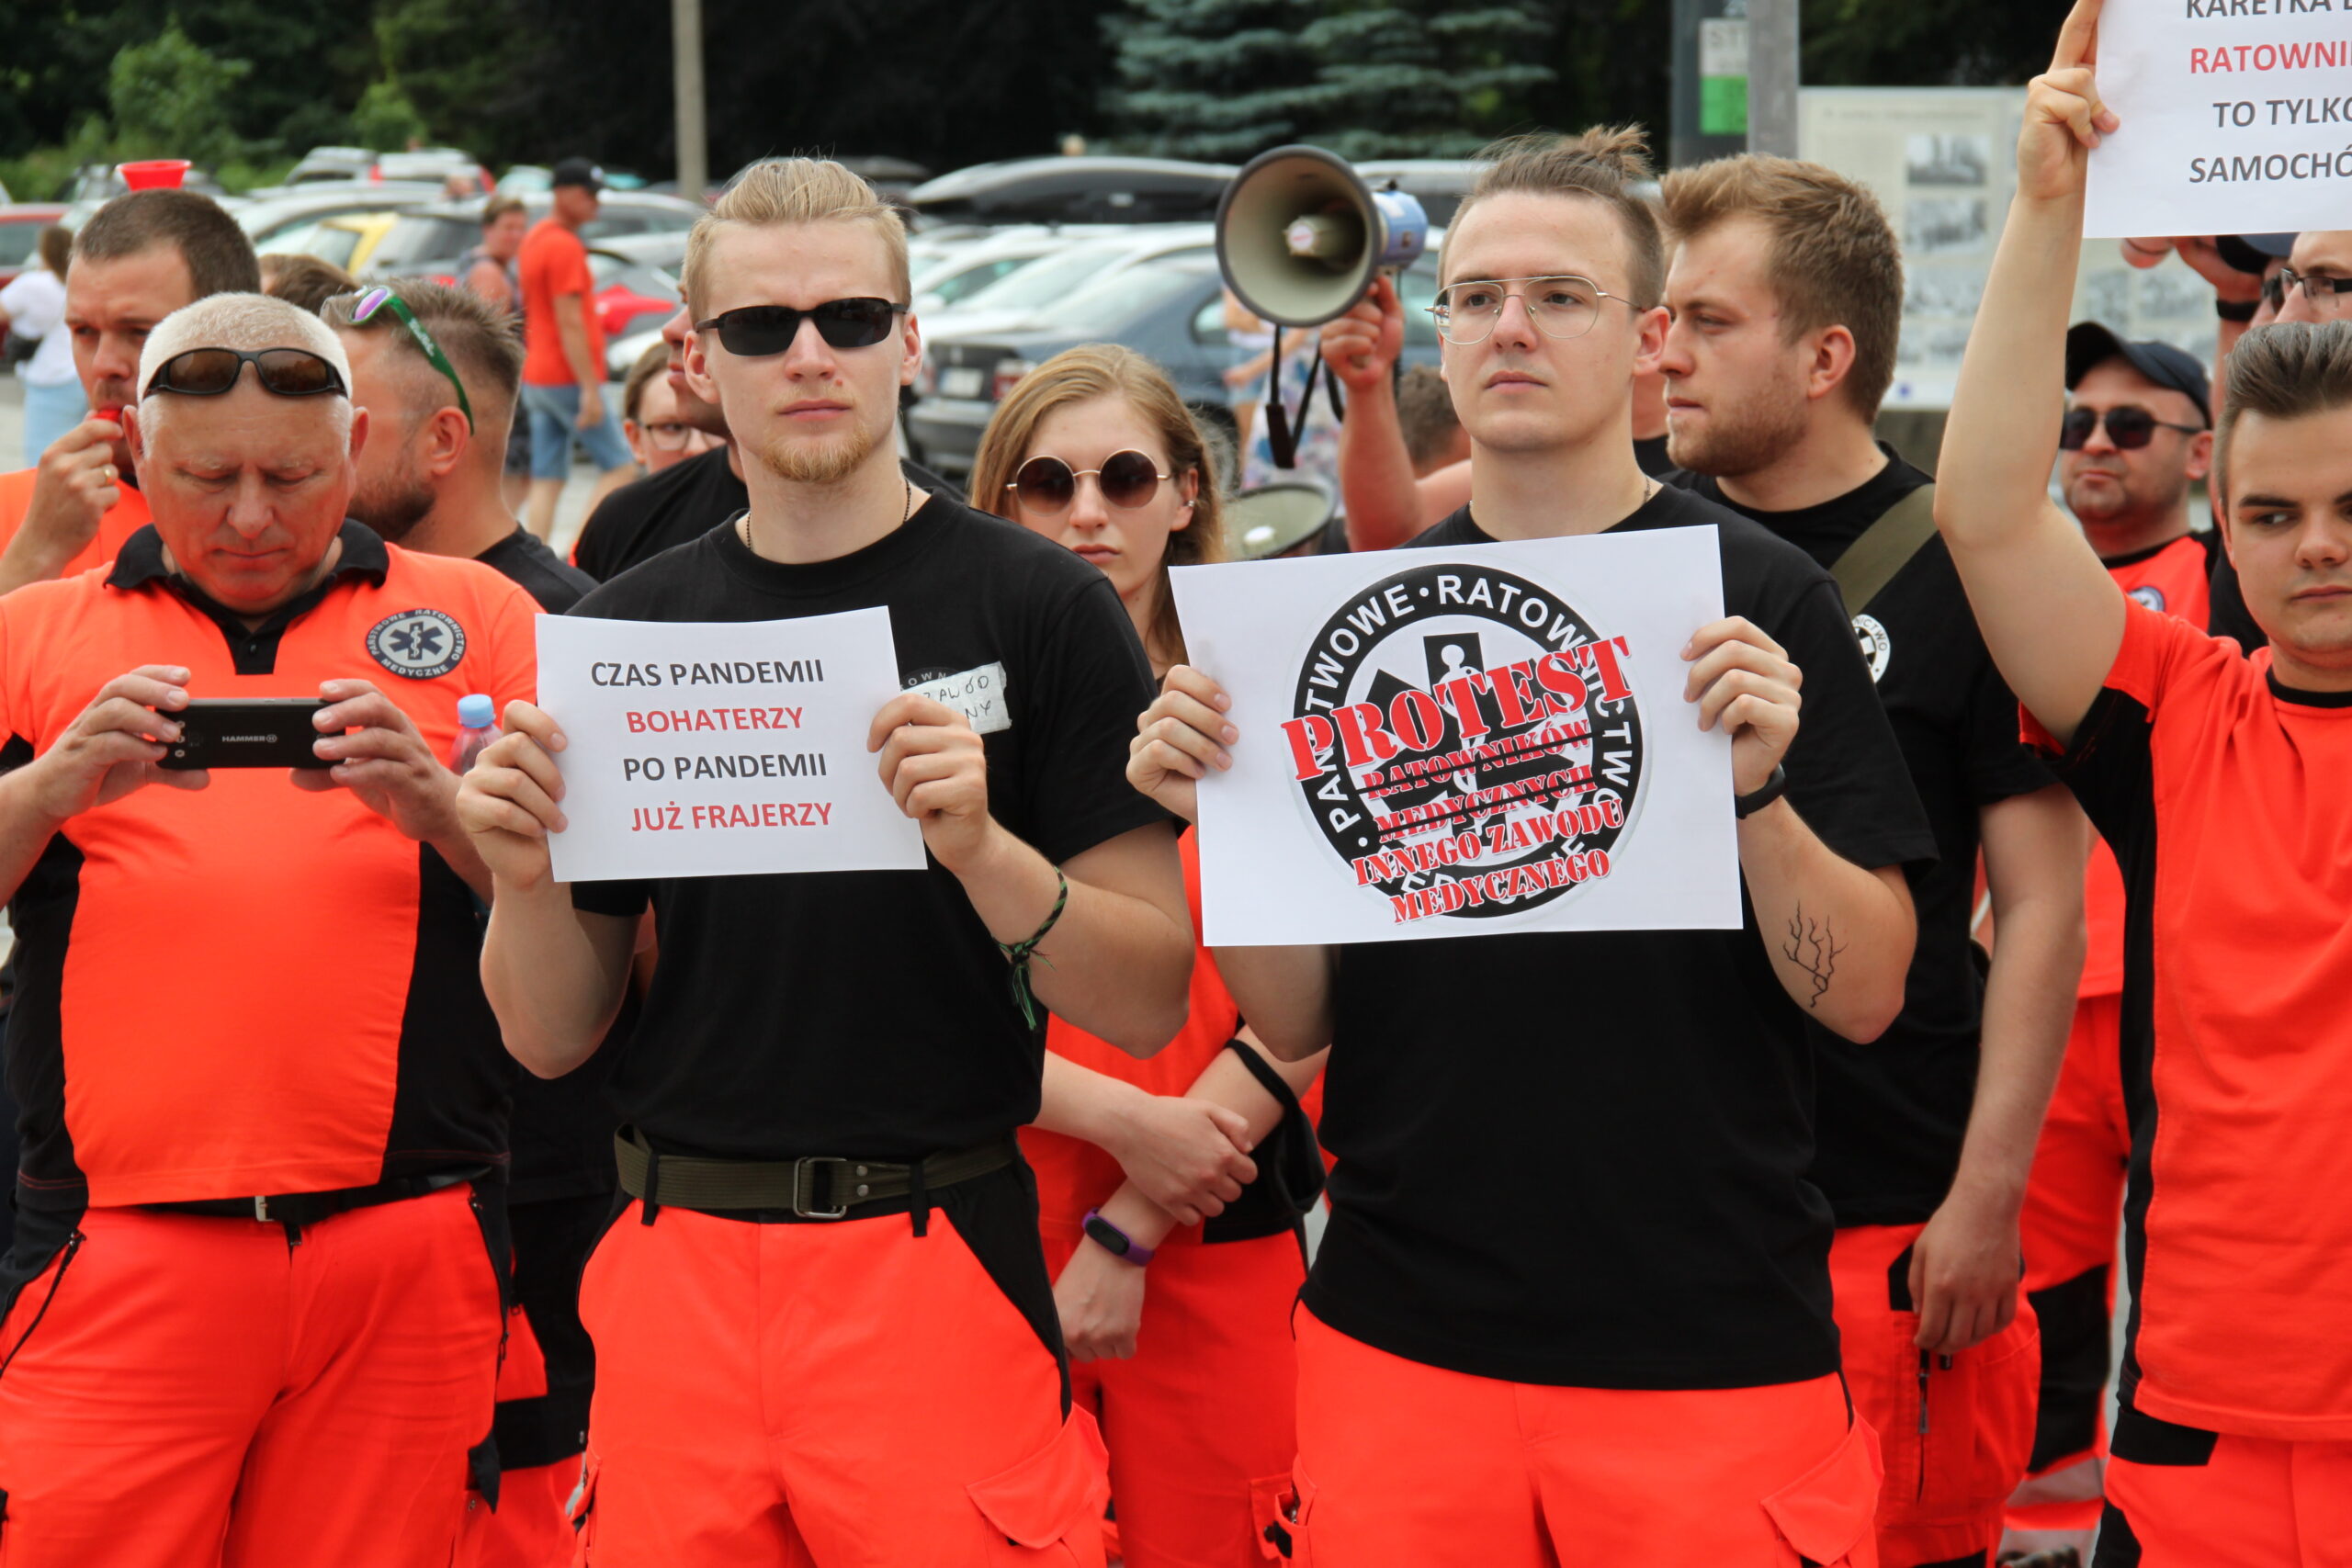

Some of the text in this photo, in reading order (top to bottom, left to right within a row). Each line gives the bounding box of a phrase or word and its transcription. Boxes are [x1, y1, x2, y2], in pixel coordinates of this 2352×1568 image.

[2191, 40, 2352, 73] RATOWNI
[2212, 101, 2256, 128] TO
[415, 609, 464, 660] RATOWNICTWO
[381, 659, 448, 677] MEDYCZNE
[591, 660, 824, 686] CZAS PANDEMII
[627, 707, 803, 733] BOHATERZY
[1280, 636, 1633, 781] PROTEST
[1306, 583, 1416, 833] PATWOWE
[623, 753, 827, 782] PO PANDEMII
[1362, 719, 1590, 800] RATOWNIKÓW
[632, 801, 832, 831] JUŻ FRAJERZY
[1374, 764, 1599, 843] MEDYCZNYCH
[1351, 831, 1483, 887] INNEGO
[1487, 797, 1624, 855] ZAWODU
[1390, 849, 1611, 924] MEDYCZNEGO
